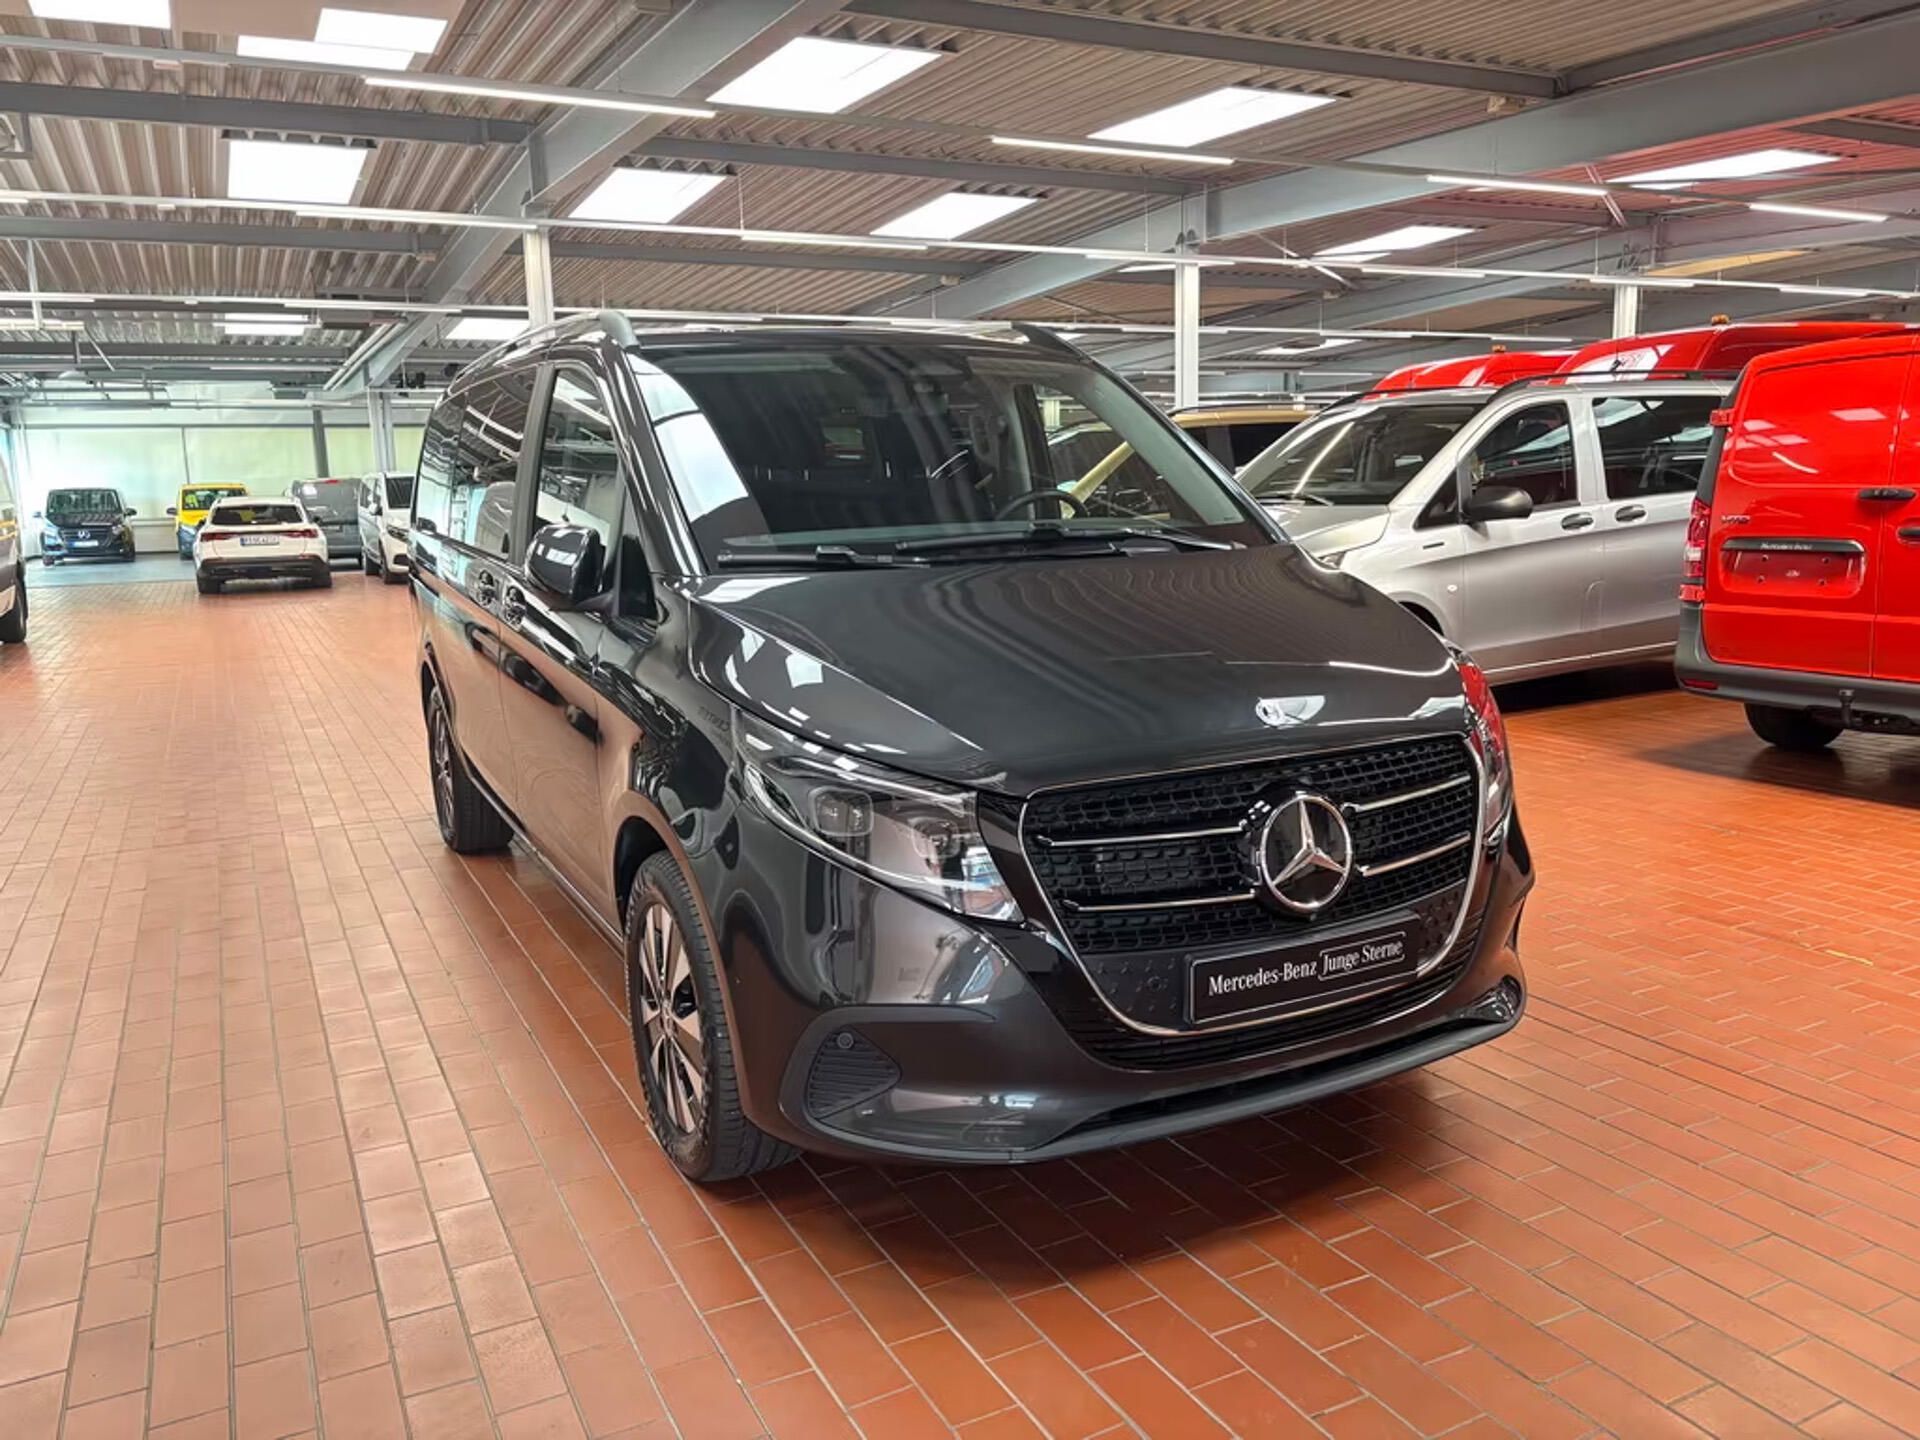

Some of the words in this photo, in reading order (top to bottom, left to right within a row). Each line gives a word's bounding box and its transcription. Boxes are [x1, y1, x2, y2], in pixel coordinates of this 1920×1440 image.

[1208, 961, 1317, 996] Mercedes-Benz
[1322, 952, 1360, 976] Junge
[1361, 941, 1403, 963] Sterne
